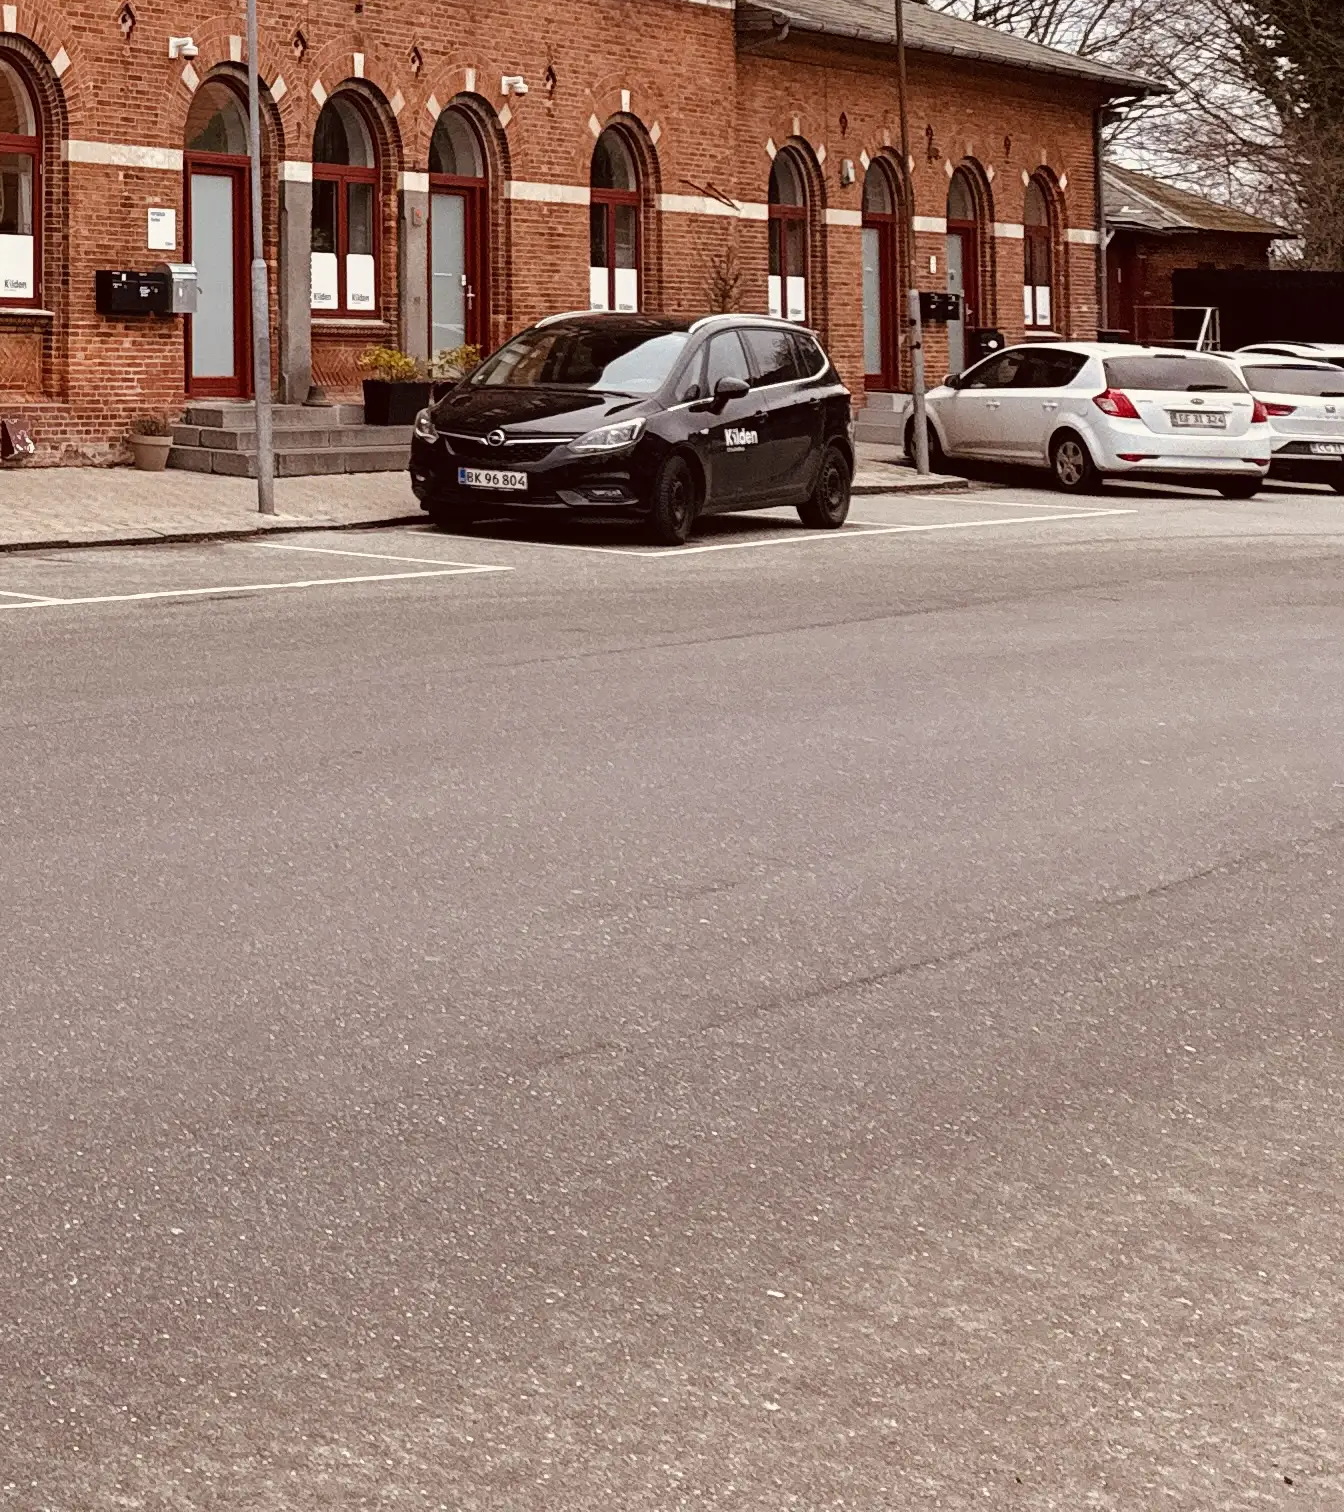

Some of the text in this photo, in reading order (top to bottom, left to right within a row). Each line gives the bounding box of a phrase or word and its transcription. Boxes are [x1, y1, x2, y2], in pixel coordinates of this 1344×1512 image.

[724, 428, 759, 446] Kilden
[467, 471, 525, 486] BK 96 804
